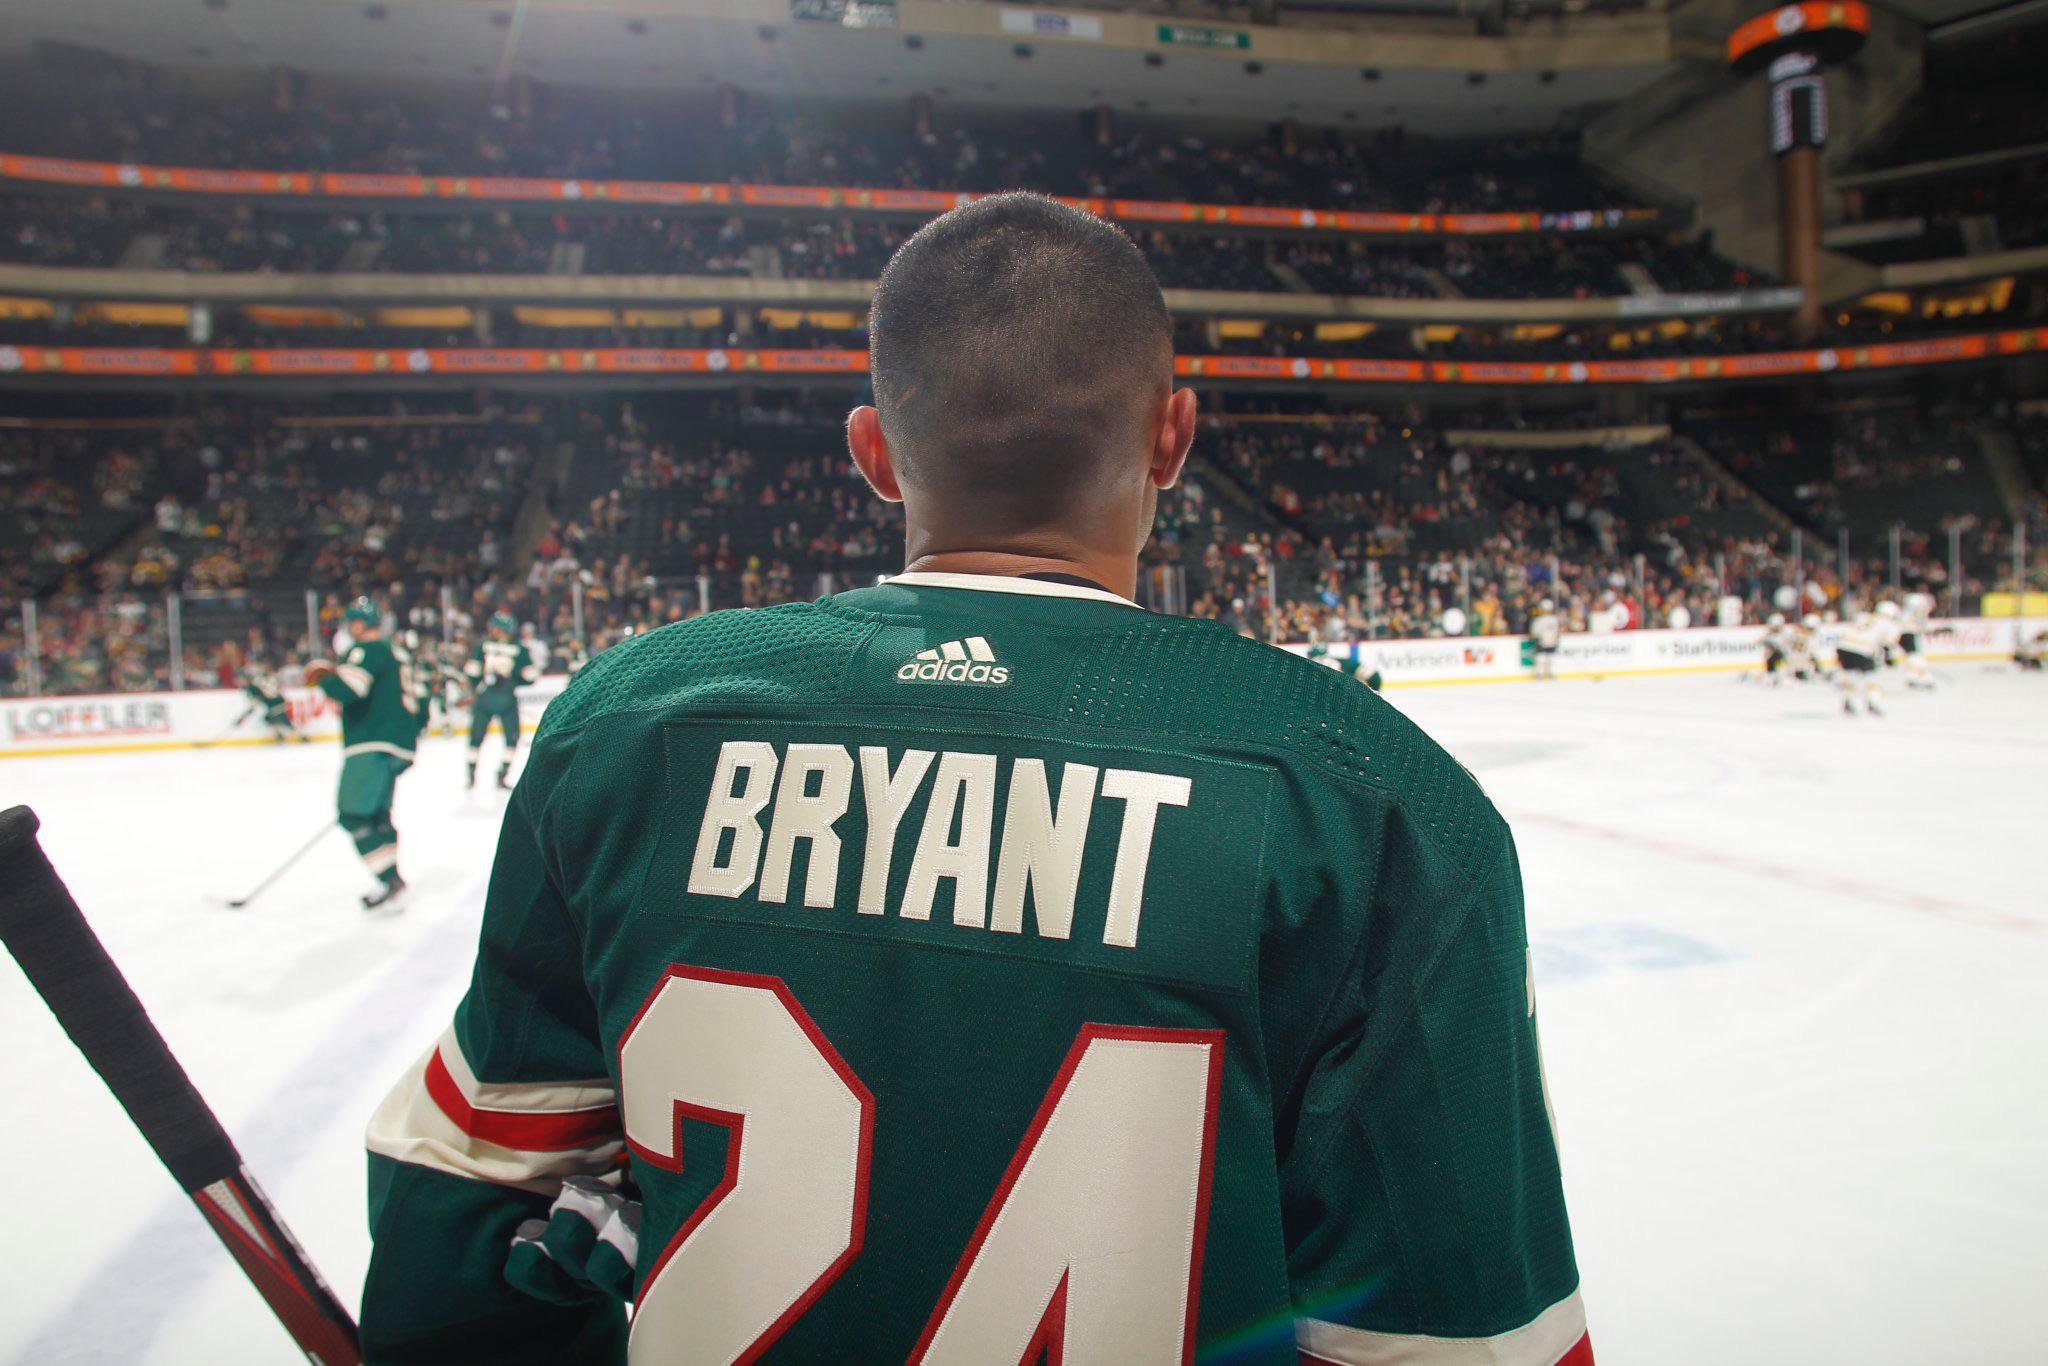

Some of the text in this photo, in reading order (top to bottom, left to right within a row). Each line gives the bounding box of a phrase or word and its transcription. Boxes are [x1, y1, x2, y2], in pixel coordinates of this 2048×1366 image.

[7, 701, 171, 733] LOFFLER
[897, 659, 1008, 684] adidas
[687, 741, 1192, 948] BRYANT
[616, 962, 1226, 1366] 24
